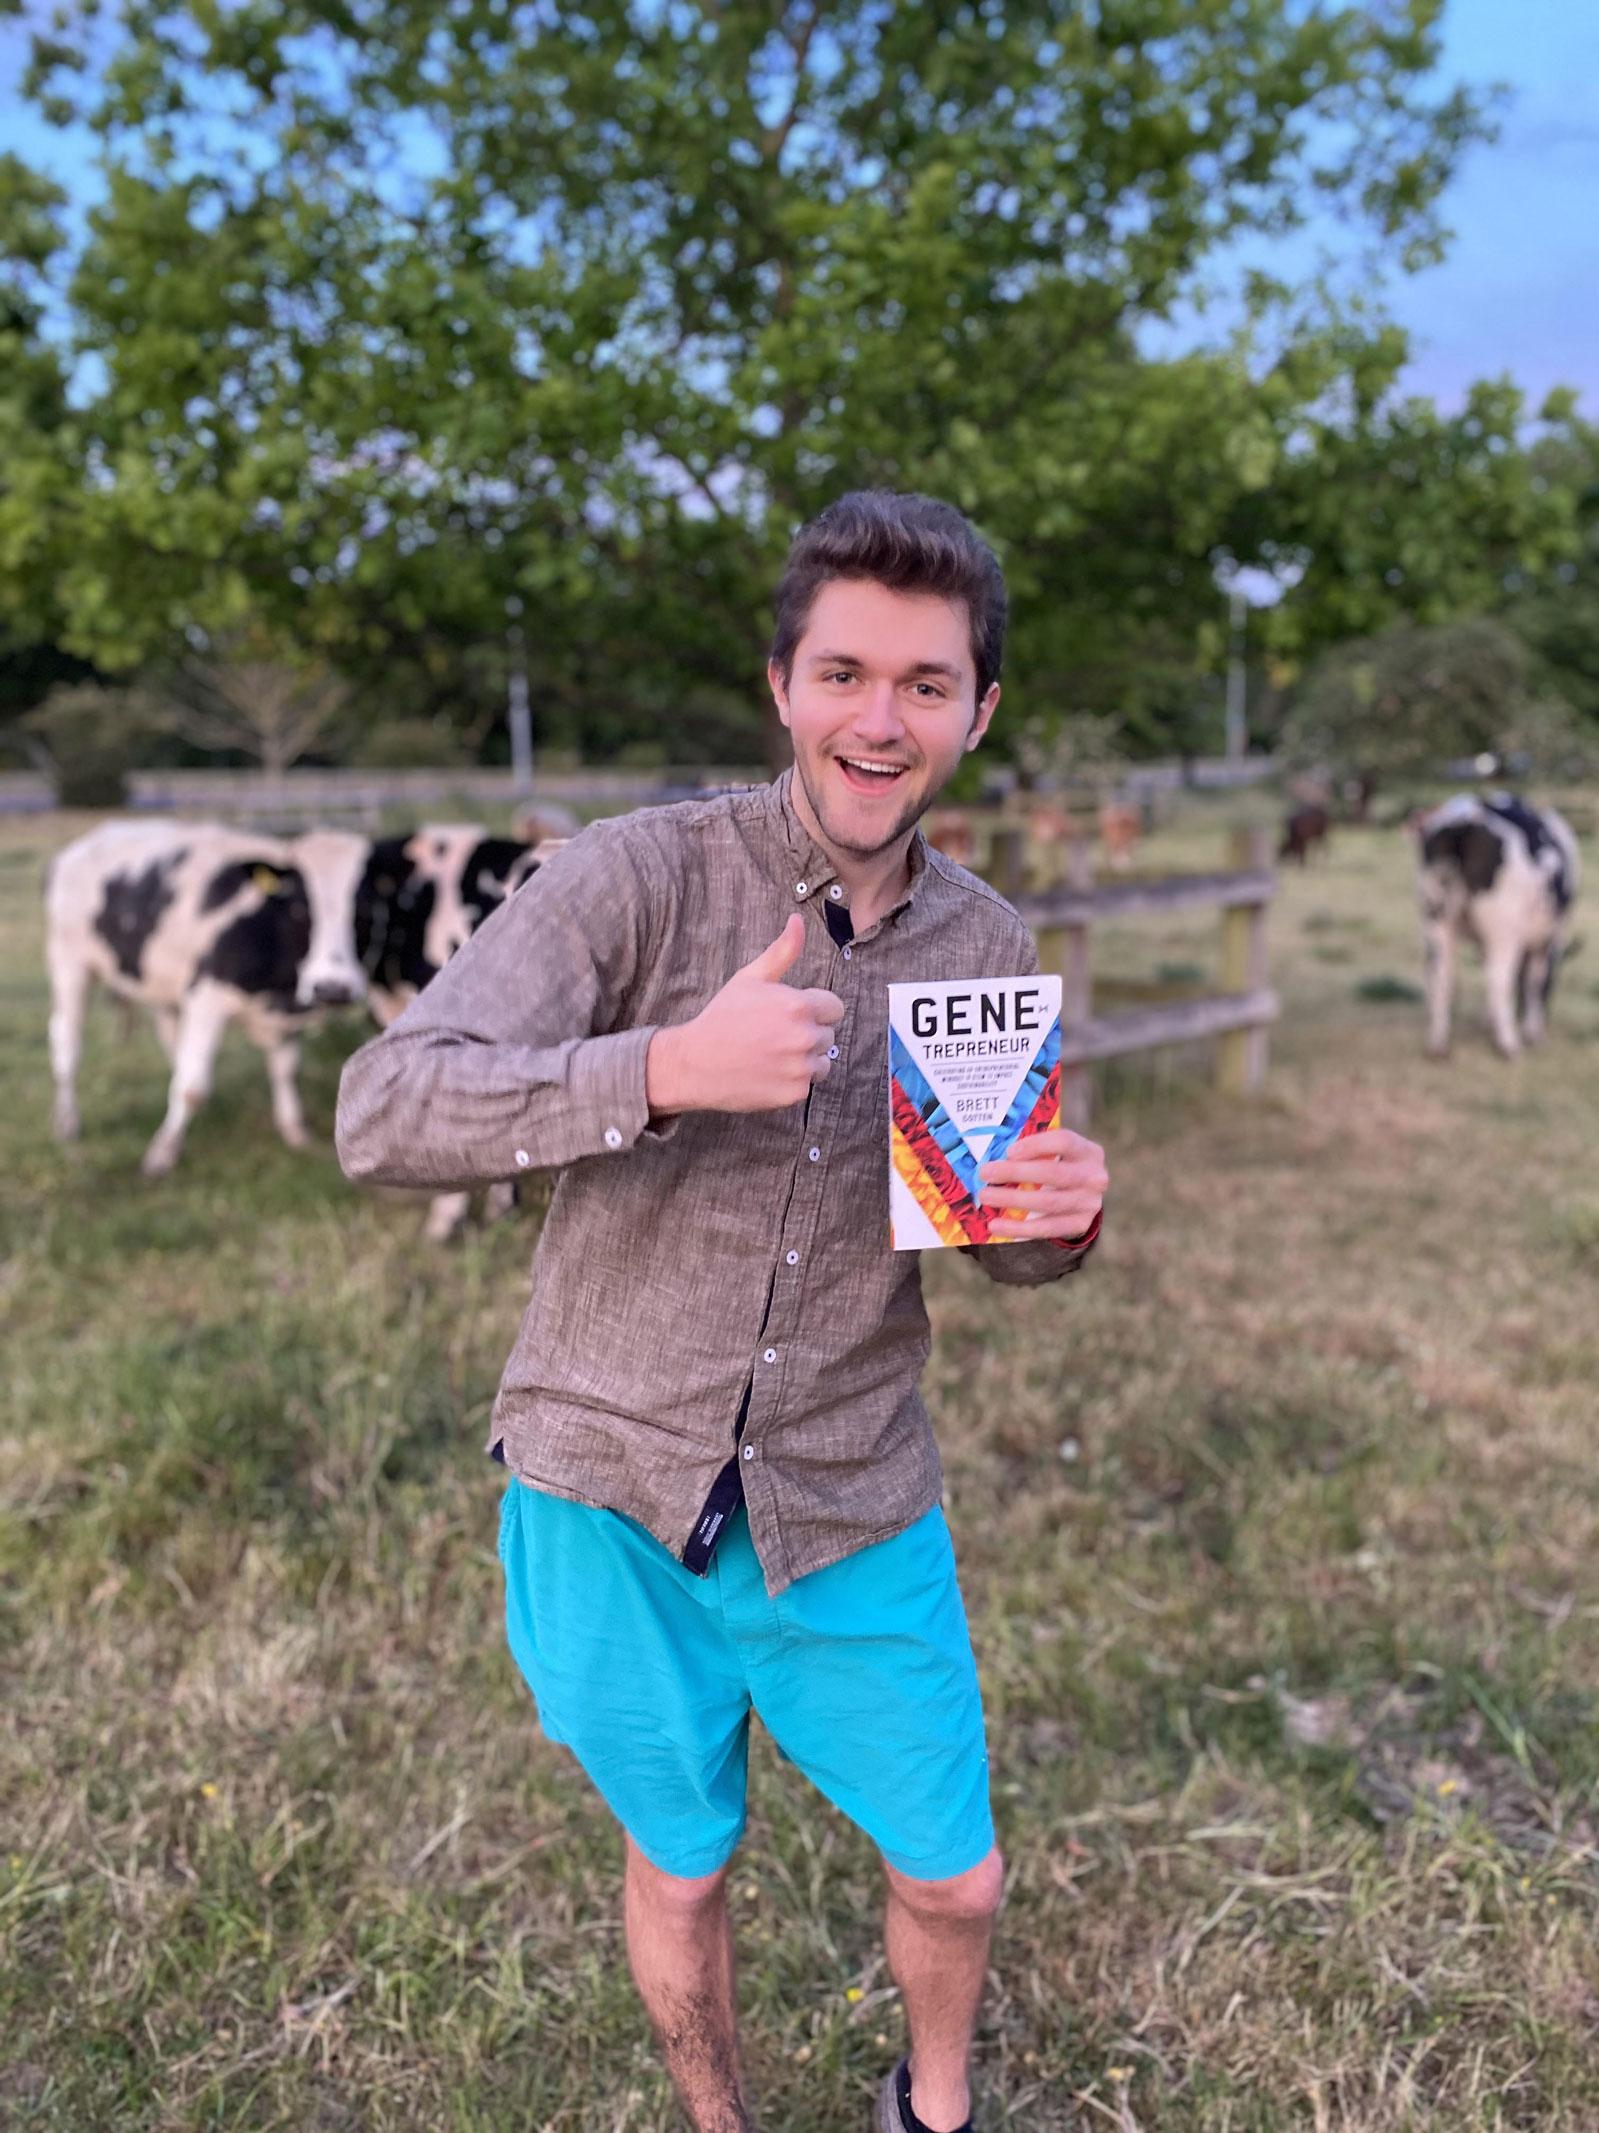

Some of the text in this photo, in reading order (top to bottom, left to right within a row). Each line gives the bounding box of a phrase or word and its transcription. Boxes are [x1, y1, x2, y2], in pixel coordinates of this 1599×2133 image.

[911, 990, 1040, 1038] GENE
[923, 1037, 1030, 1060] TREPRENEUR
[956, 1096, 999, 1112] BRETT
